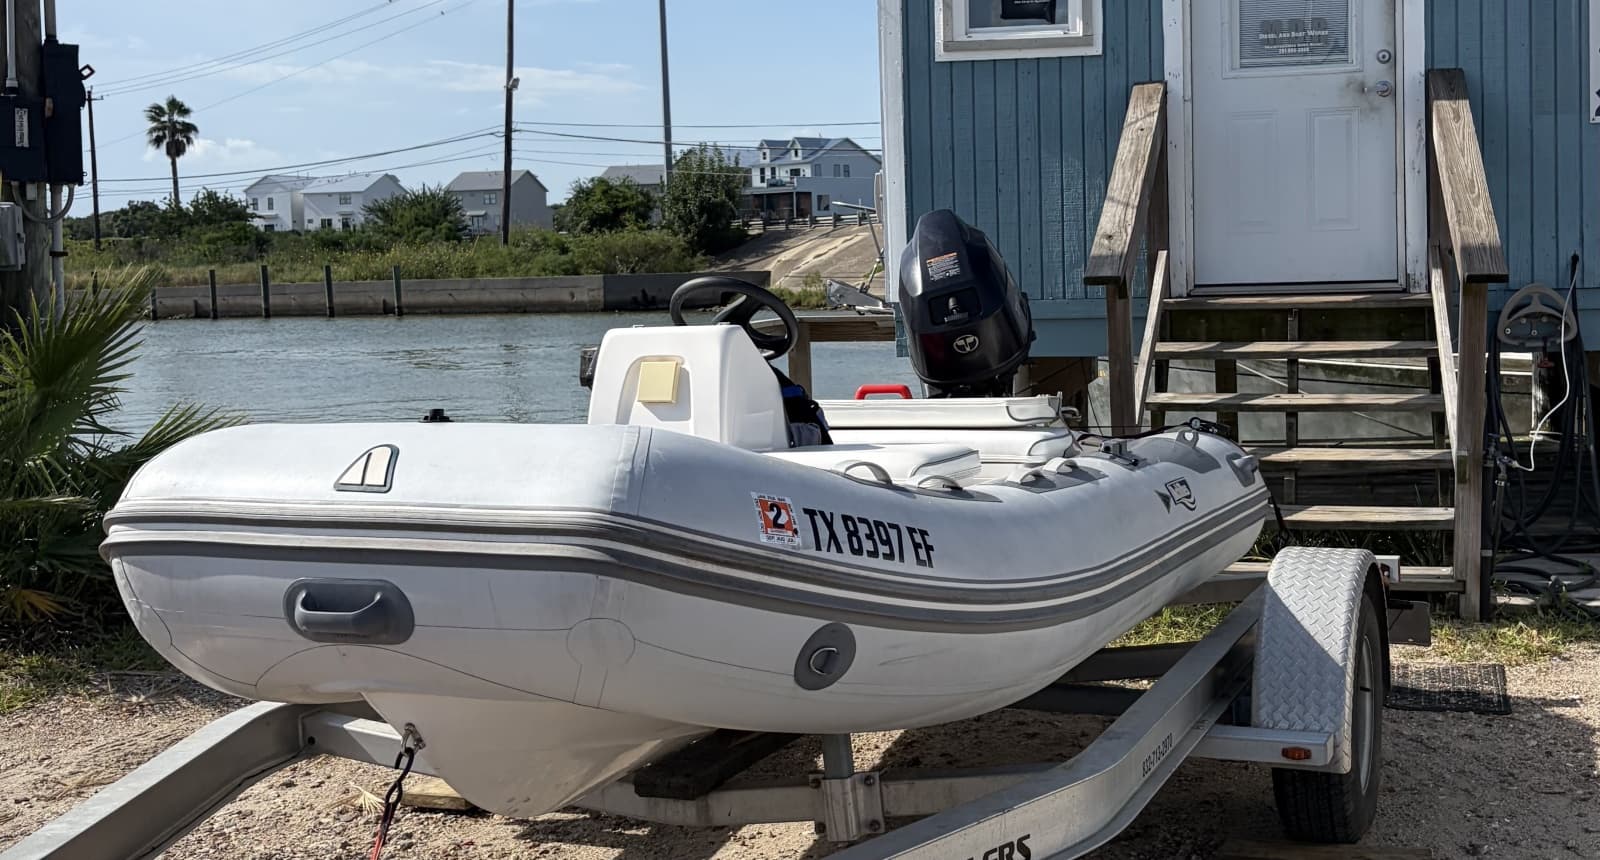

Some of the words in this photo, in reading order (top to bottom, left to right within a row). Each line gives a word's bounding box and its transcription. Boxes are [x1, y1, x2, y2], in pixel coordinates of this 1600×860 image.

[769, 503, 785, 529] 2
[803, 508, 843, 553] TX
[841, 514, 904, 563] 8397
[905, 527, 934, 568] EF
